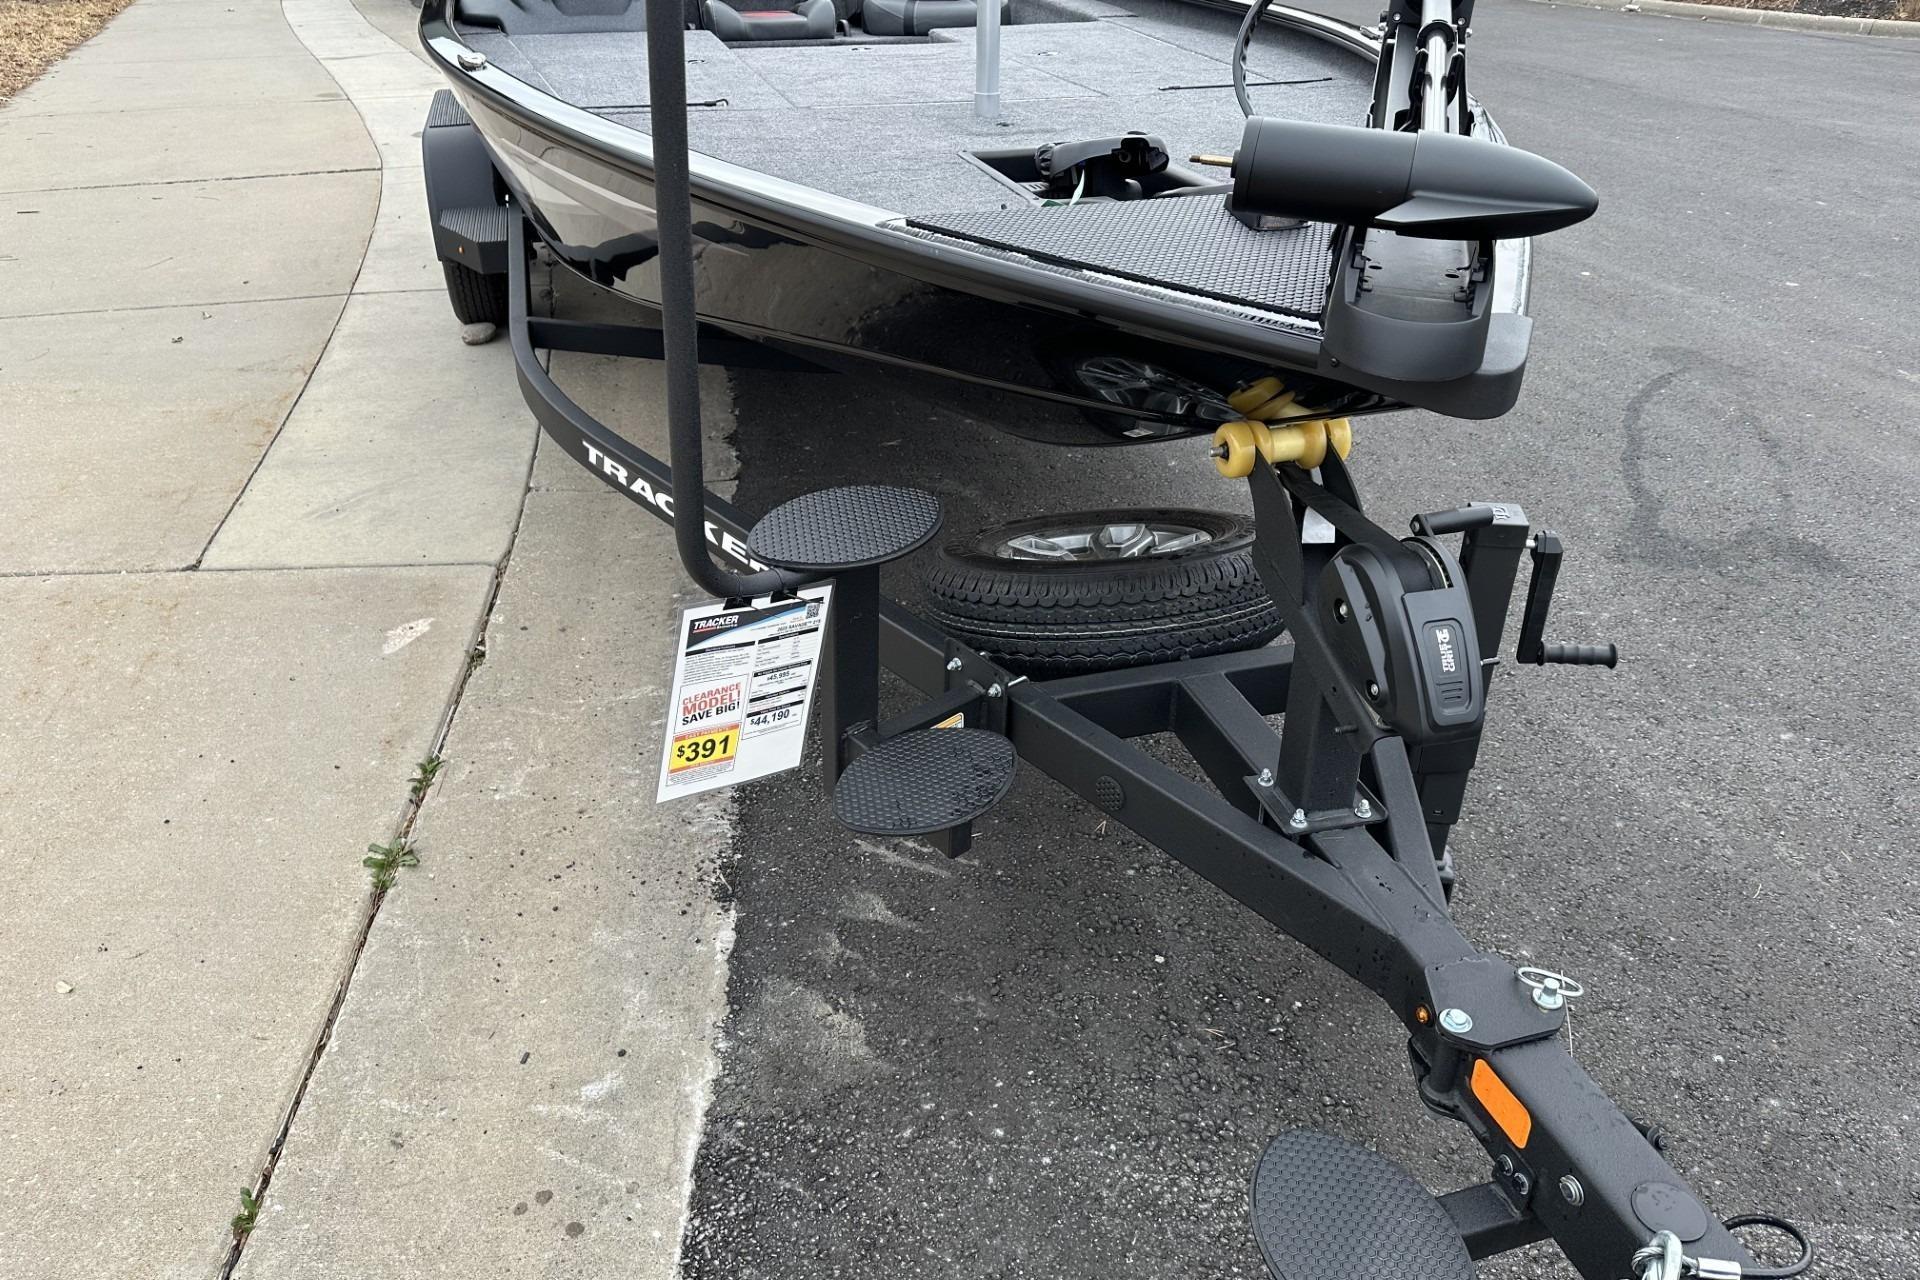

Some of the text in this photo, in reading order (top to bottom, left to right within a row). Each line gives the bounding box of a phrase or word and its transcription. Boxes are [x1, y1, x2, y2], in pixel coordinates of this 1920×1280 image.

[694, 615, 739, 630] TRACKER
[682, 682, 741, 706] CLEARANCE
[682, 689, 741, 717] MODEL!
[682, 708, 713, 726] SAVE
[715, 701, 740, 716] BIG!
[750, 708, 790, 726] $44,190
[676, 734, 730, 763] $391
